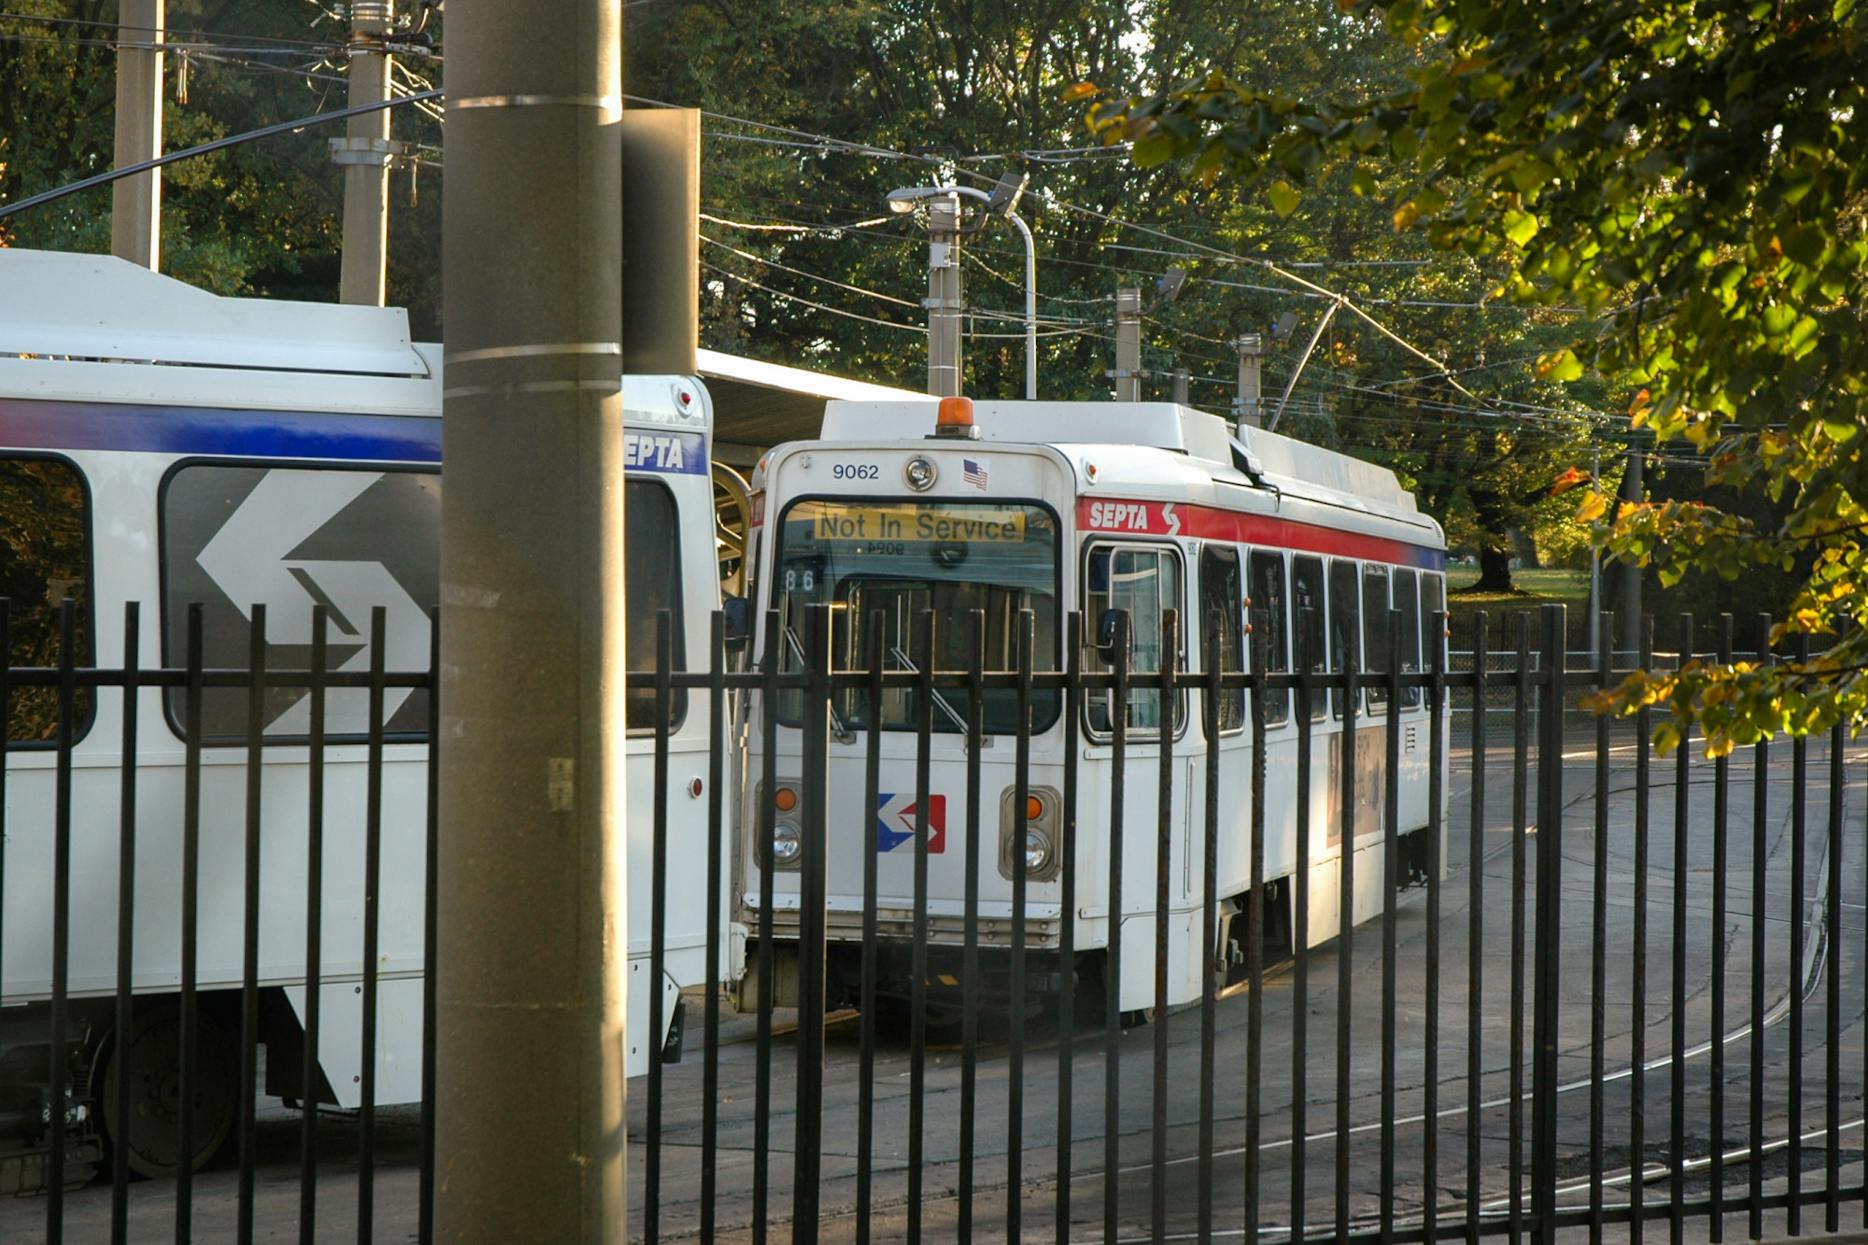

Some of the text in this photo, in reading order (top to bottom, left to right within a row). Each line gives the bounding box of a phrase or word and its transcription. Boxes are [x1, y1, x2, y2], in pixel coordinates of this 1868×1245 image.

[624, 434, 684, 469] EPTA
[832, 464, 880, 480] 9062
[819, 511, 1018, 541] Not In Service
[1089, 502, 1148, 530] SEPTA
